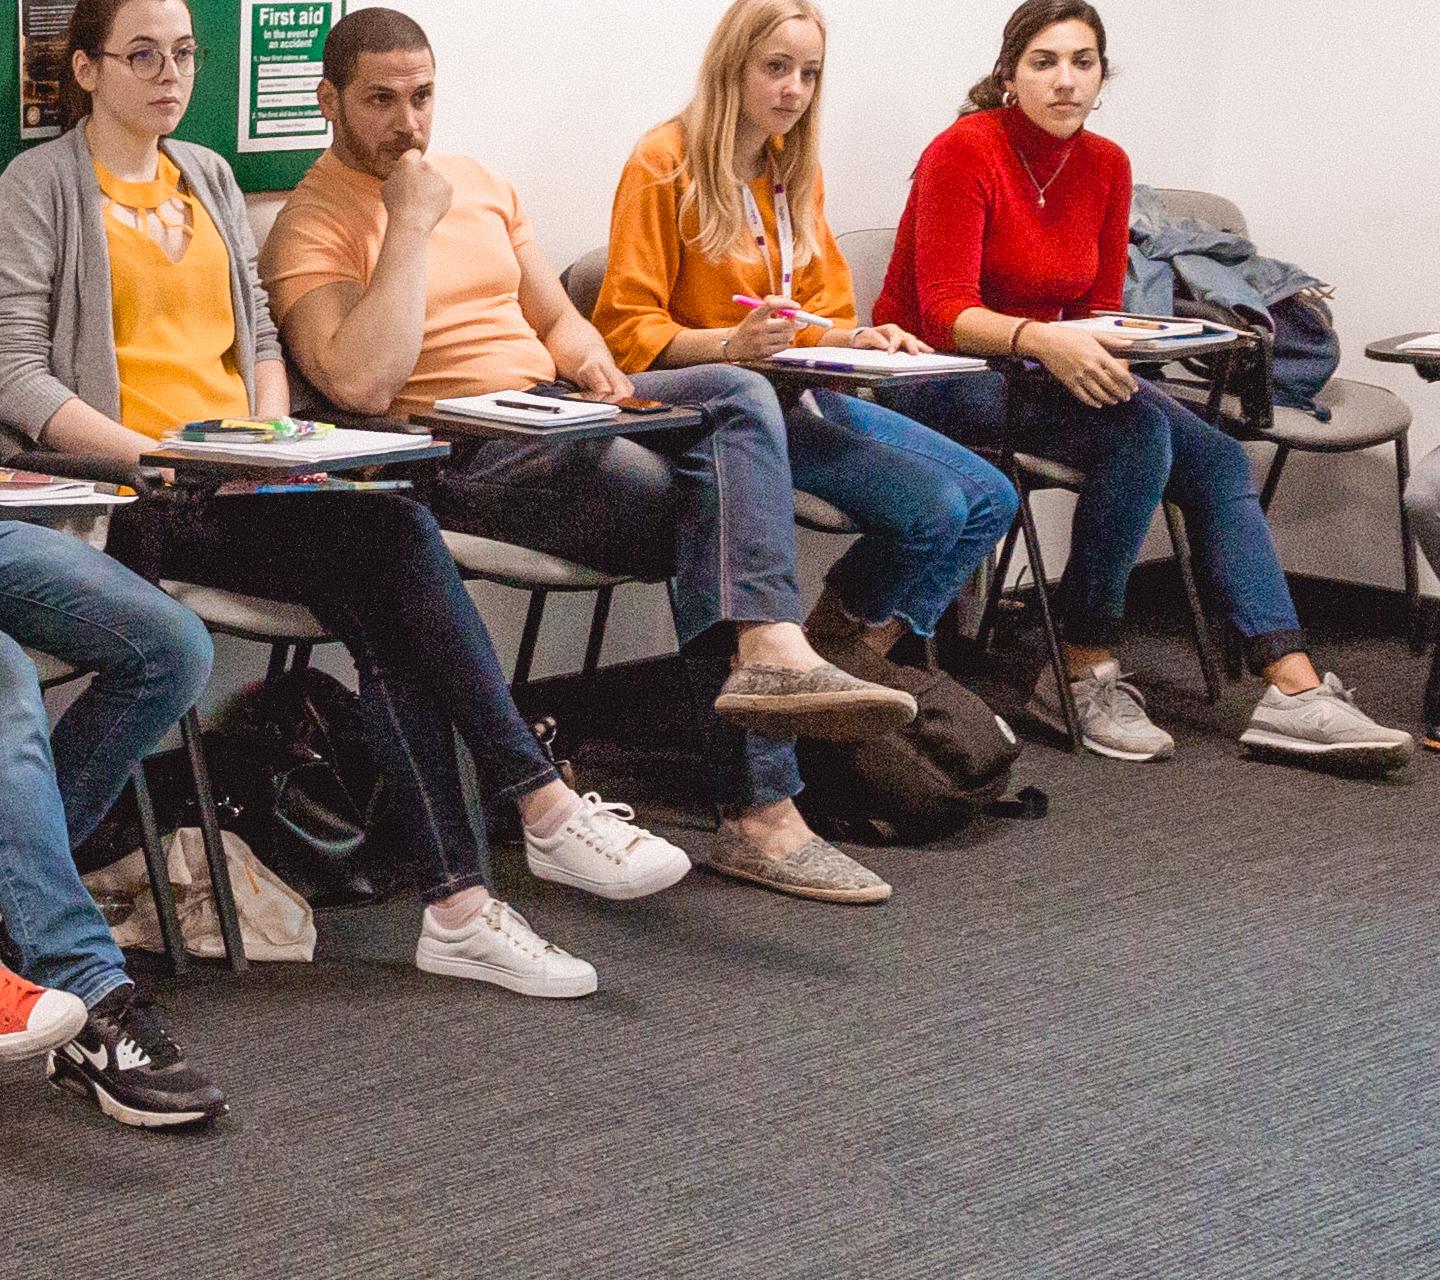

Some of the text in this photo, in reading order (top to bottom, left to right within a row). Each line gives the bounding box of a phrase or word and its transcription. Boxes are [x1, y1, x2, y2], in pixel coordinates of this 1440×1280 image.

[259, 6, 324, 27] First aid
[263, 28, 319, 39] In the event of
[268, 39, 312, 49] an accident
